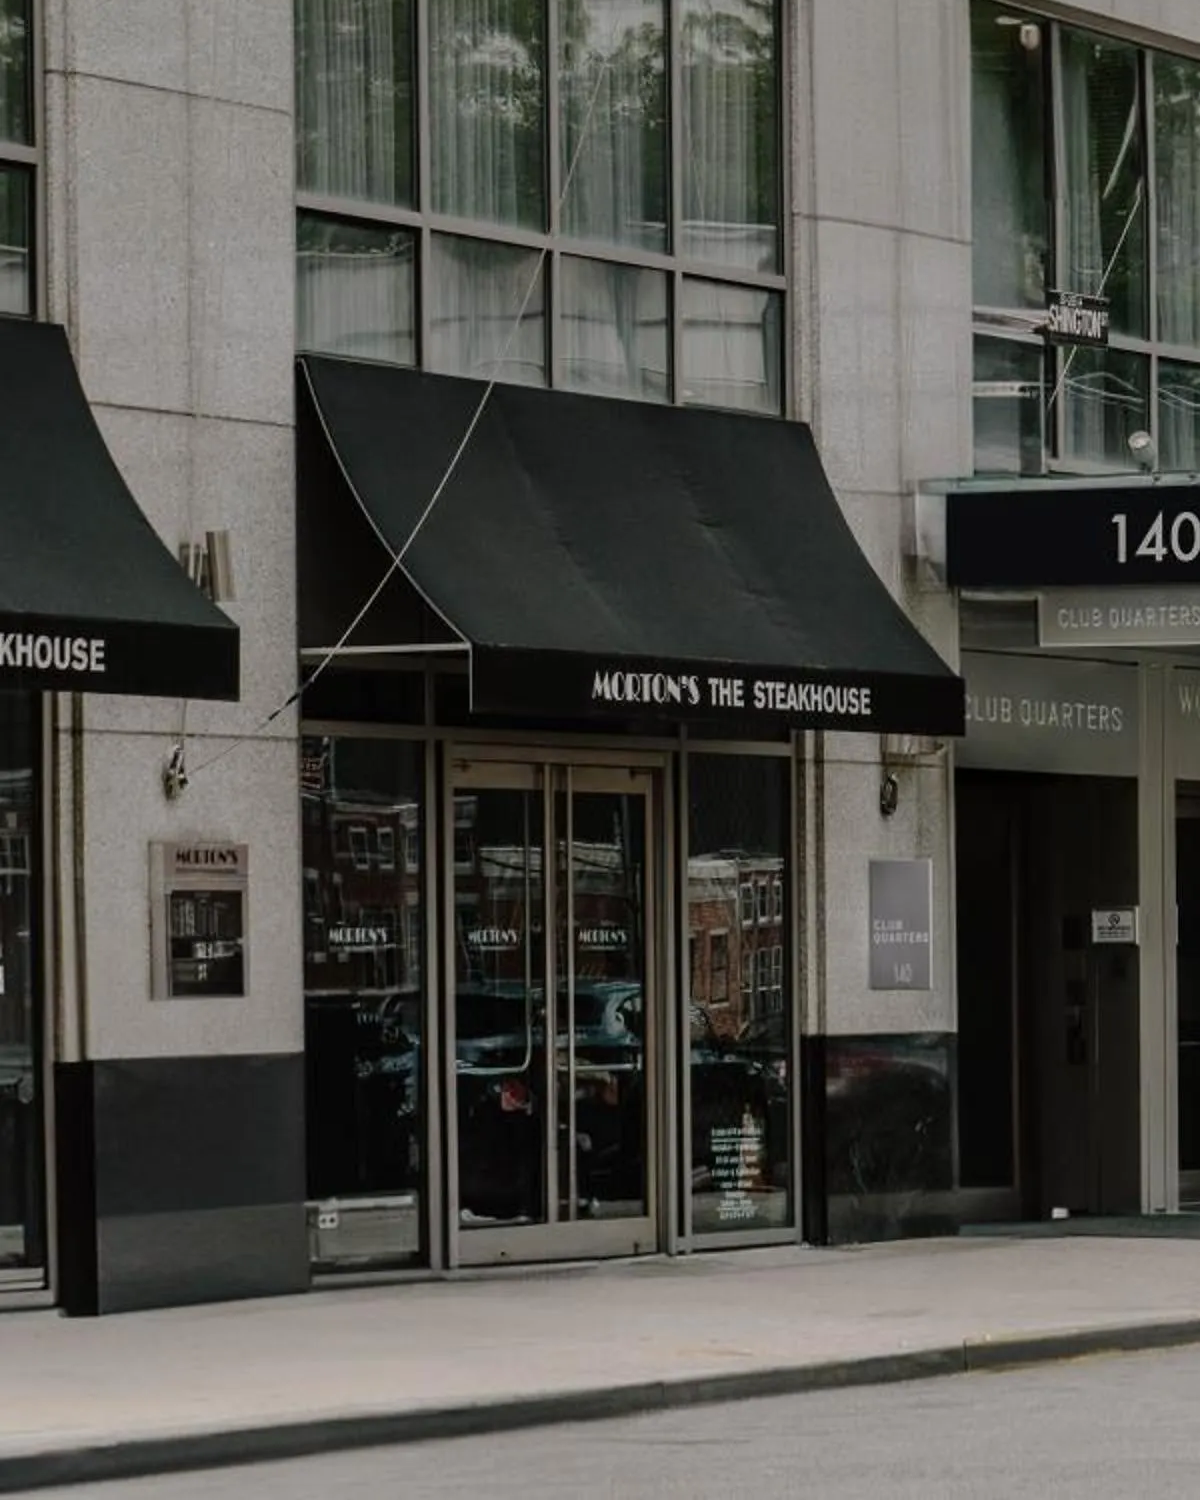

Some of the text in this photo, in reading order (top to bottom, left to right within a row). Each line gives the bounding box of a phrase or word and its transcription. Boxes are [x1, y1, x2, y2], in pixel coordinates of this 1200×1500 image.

[1057, 608, 1103, 629] CLUB
[592, 670, 872, 715] MORTON'S THE STEAKHOUSE
[1020, 698, 1124, 731] QUARTERS
